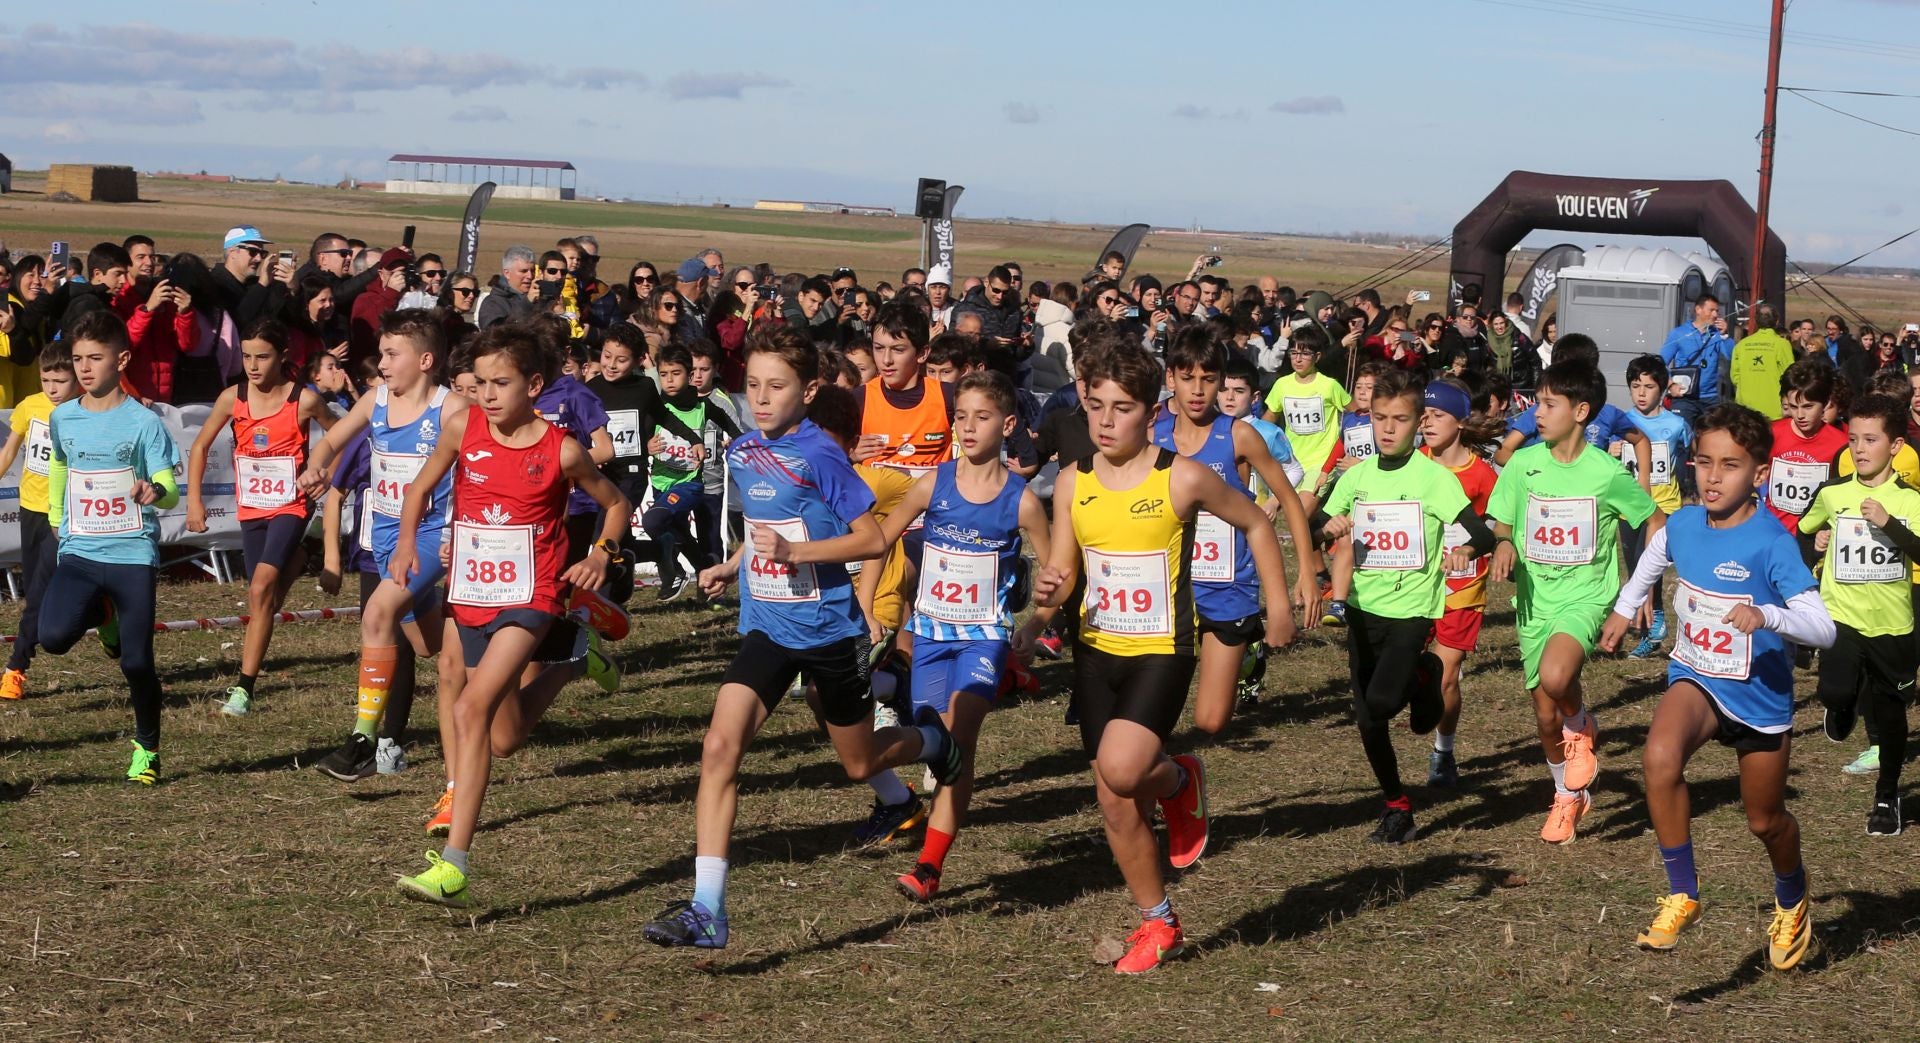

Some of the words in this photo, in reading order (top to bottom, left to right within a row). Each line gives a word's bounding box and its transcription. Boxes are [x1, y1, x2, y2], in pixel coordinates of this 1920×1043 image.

[1555, 194, 1585, 217] YOU
[1586, 196, 1629, 219] EVEN
[1287, 412, 1321, 424] 1113
[31, 443, 52, 462] 15
[248, 477, 286, 495] 284
[1774, 482, 1818, 501] 103
[79, 497, 127, 517] 795
[947, 524, 979, 537] CLUB
[1362, 530, 1410, 551] 280
[1533, 526, 1580, 546] 481
[1839, 544, 1901, 565] 1162
[465, 558, 518, 584] 388
[750, 554, 799, 579] 444
[1713, 566, 1750, 579] CRONOS
[930, 580, 979, 604] 421
[1096, 586, 1153, 613] 319
